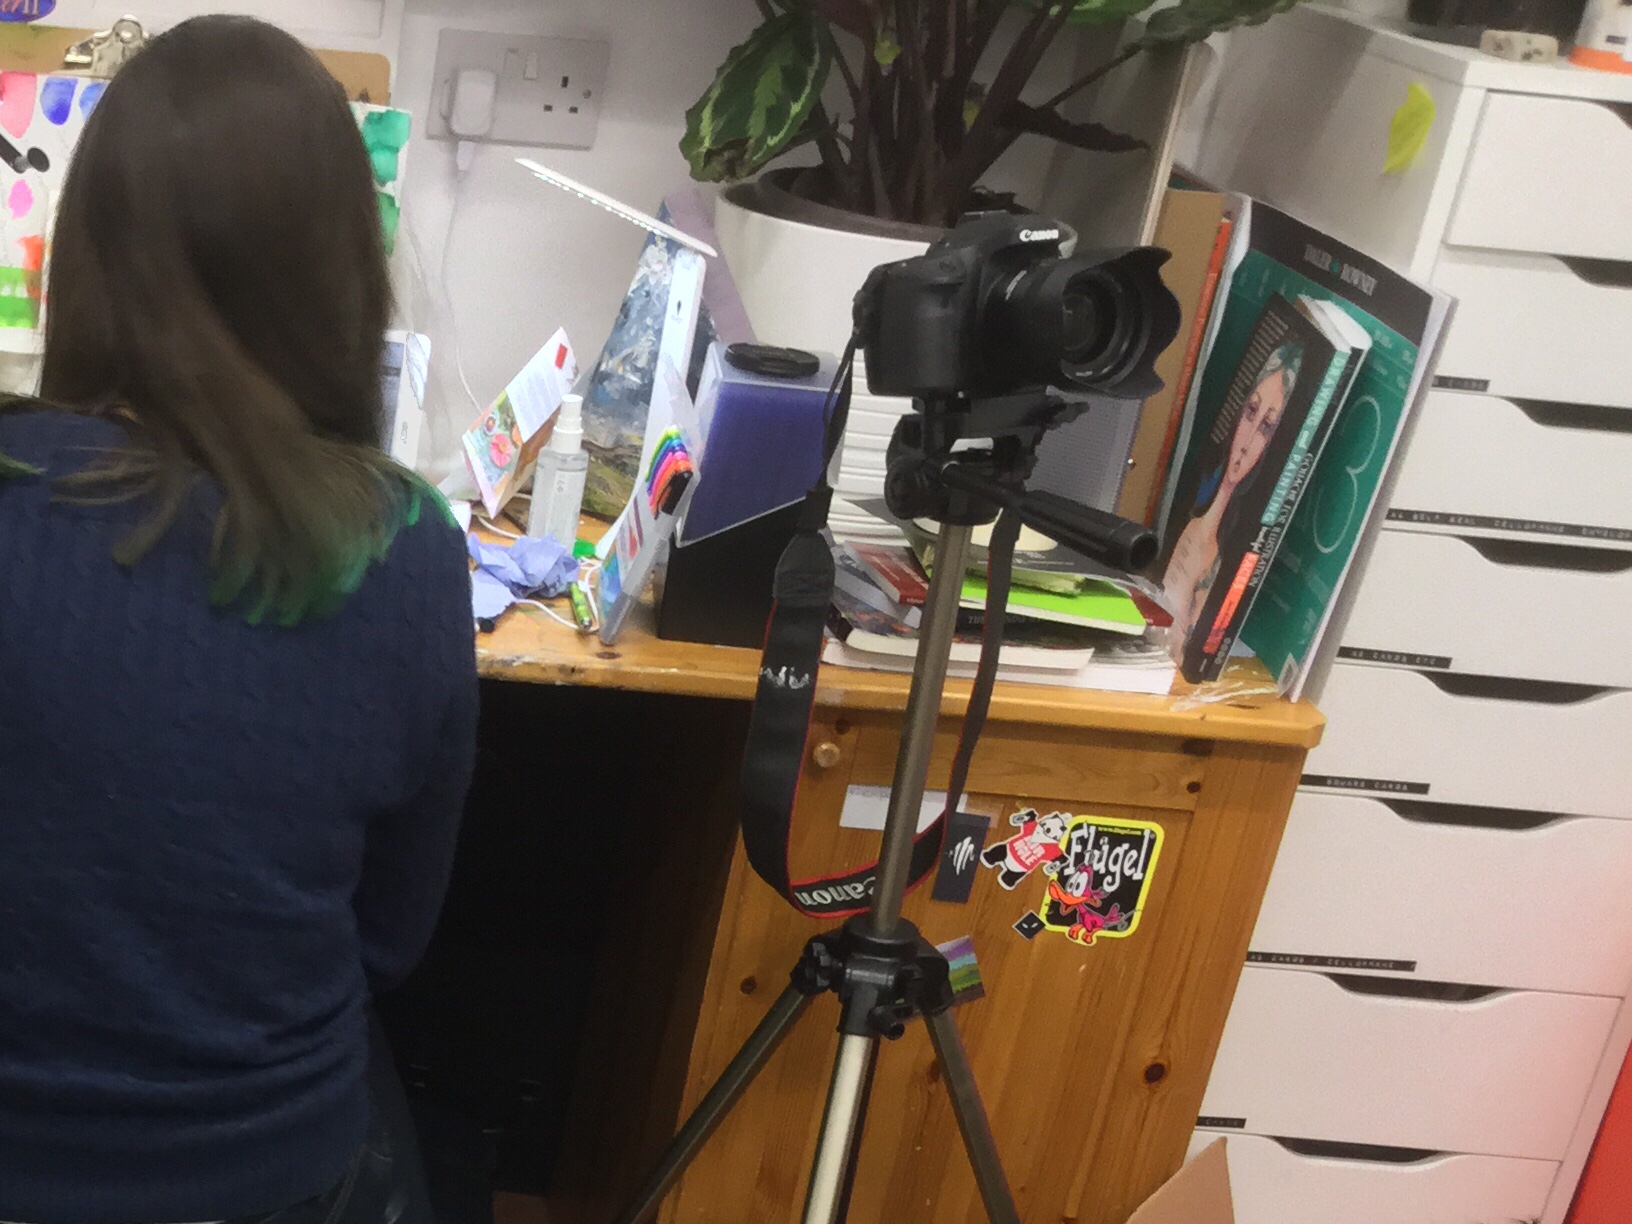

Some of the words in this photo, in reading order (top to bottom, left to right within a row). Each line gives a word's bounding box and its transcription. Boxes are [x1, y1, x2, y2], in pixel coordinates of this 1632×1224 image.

[1019, 229, 1059, 242] Canon
[1306, 354, 1347, 428] DRAWING
[1262, 453, 1302, 524] PAINTING
[1249, 526, 1282, 588] ILLUSTRATION
[1372, 653, 1408, 663] CARDS
[1326, 778, 1365, 788] SQUARE
[1374, 783, 1409, 791] CARDS
[1063, 822, 1151, 892] Flügel
